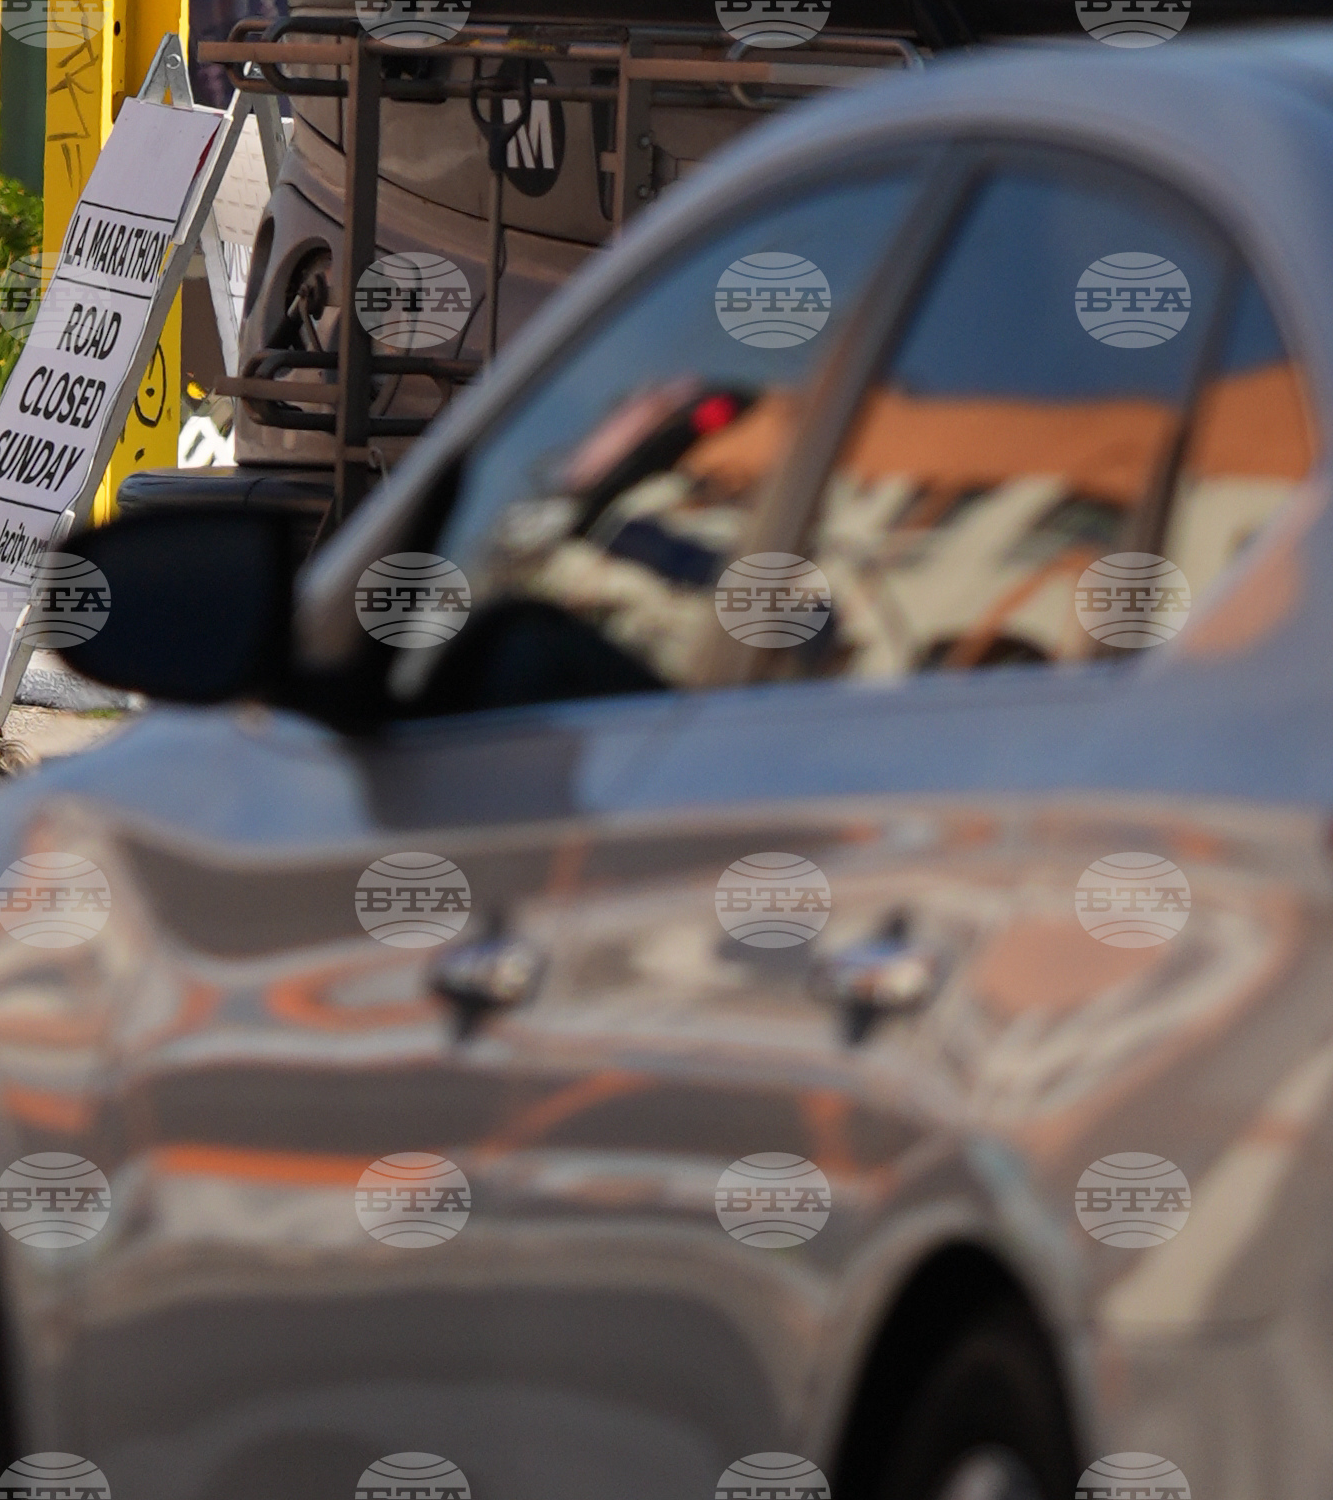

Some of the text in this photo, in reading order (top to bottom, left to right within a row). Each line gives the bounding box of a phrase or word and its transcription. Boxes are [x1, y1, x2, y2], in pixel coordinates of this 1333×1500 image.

[63, 214, 93, 267] LA
[83, 217, 172, 284] MARATHON
[56, 302, 122, 361] ROAD
[19, 364, 107, 430] CLOSED
